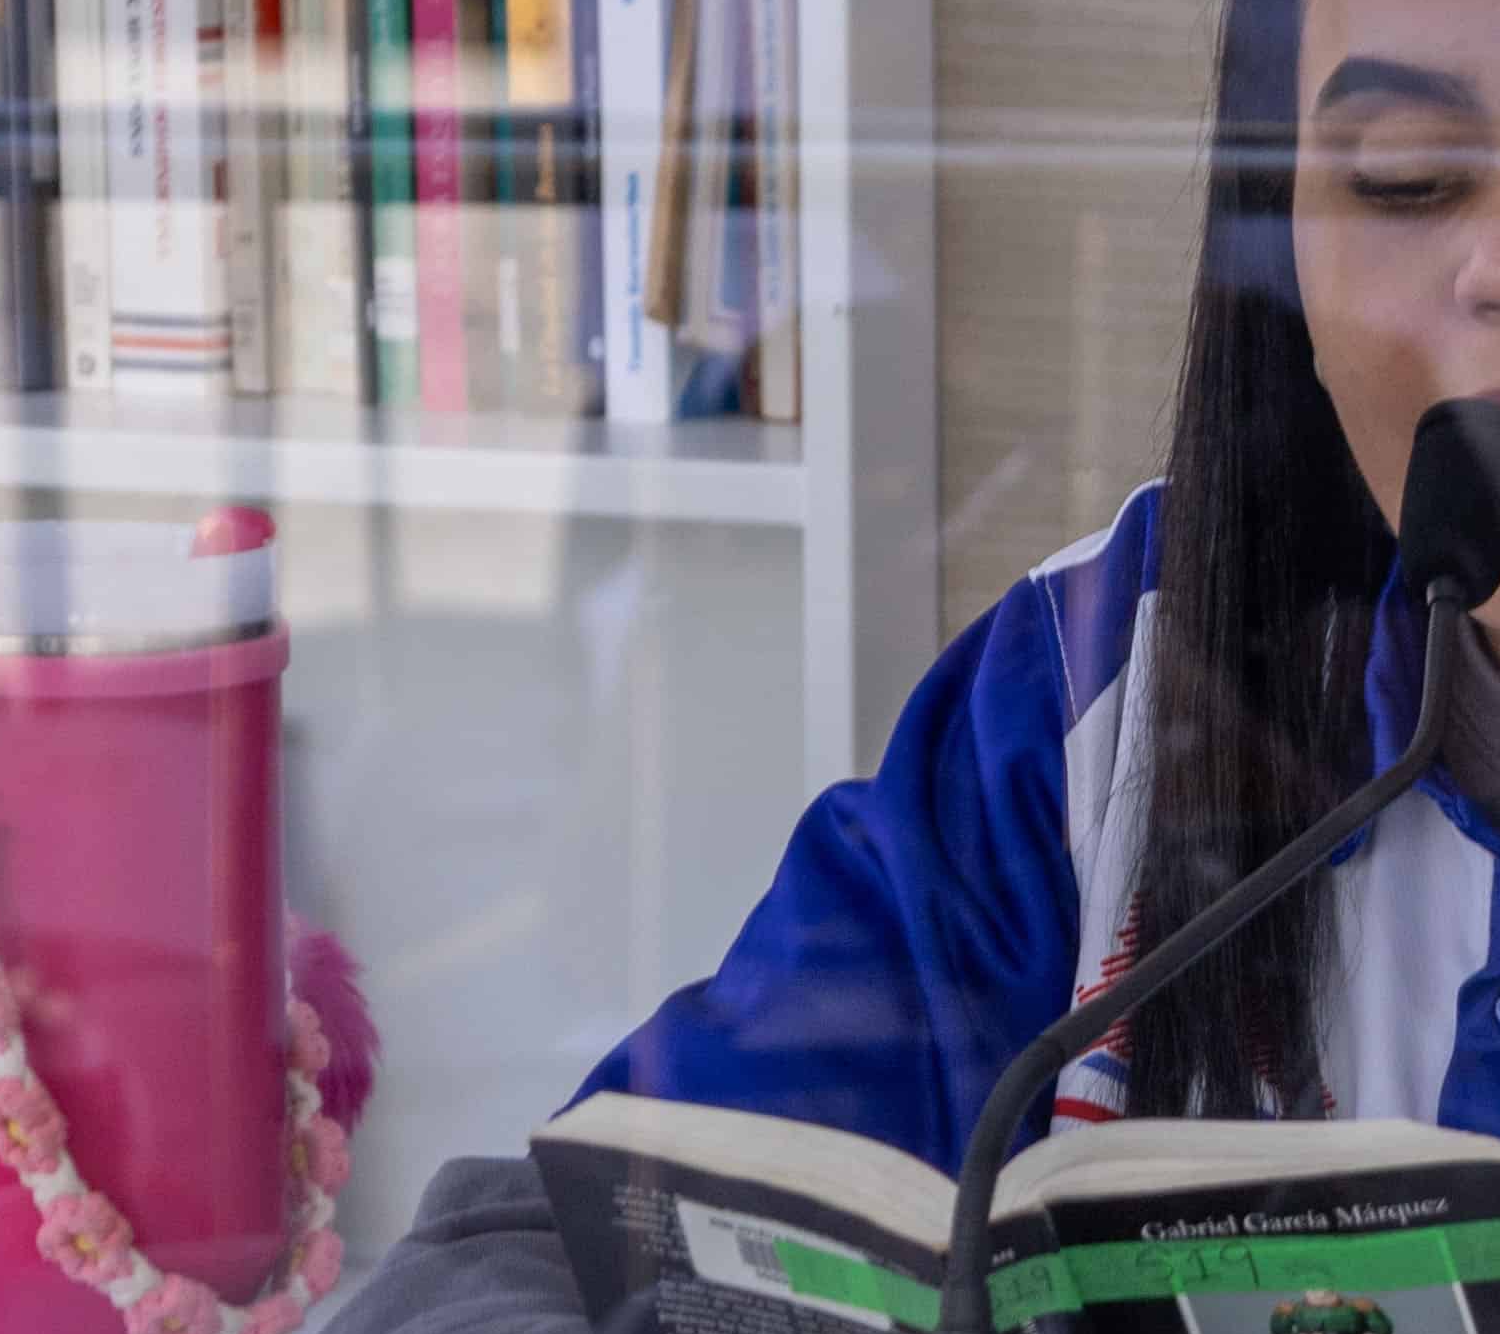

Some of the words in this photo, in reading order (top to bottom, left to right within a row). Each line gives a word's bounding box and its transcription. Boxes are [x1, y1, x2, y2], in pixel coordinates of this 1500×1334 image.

[1141, 1209, 1238, 1242] Gabriel
[1243, 1203, 1329, 1235] García
[1336, 1196, 1450, 1227] Márquez
